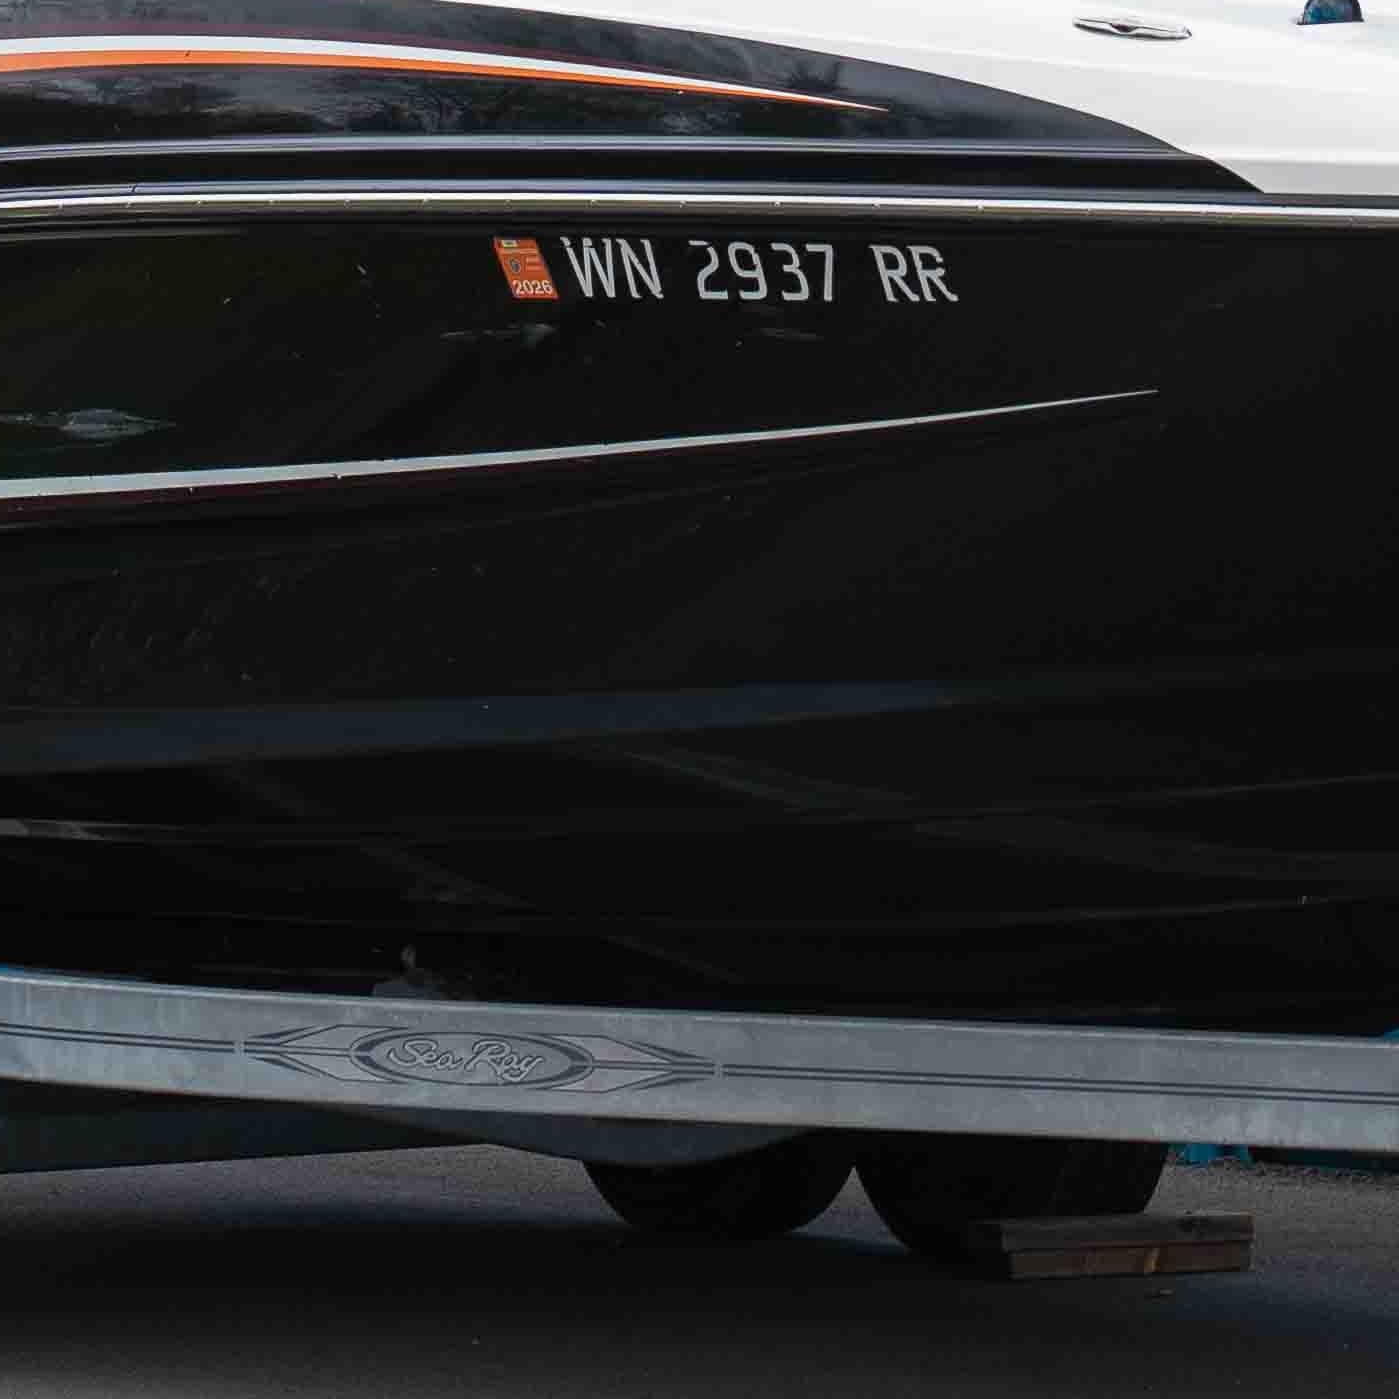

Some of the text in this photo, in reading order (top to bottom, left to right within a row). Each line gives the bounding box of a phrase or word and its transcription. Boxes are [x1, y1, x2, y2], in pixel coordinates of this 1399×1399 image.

[560, 236, 960, 302] WN 2937 RR
[387, 1038, 546, 1082] Sea Ray
